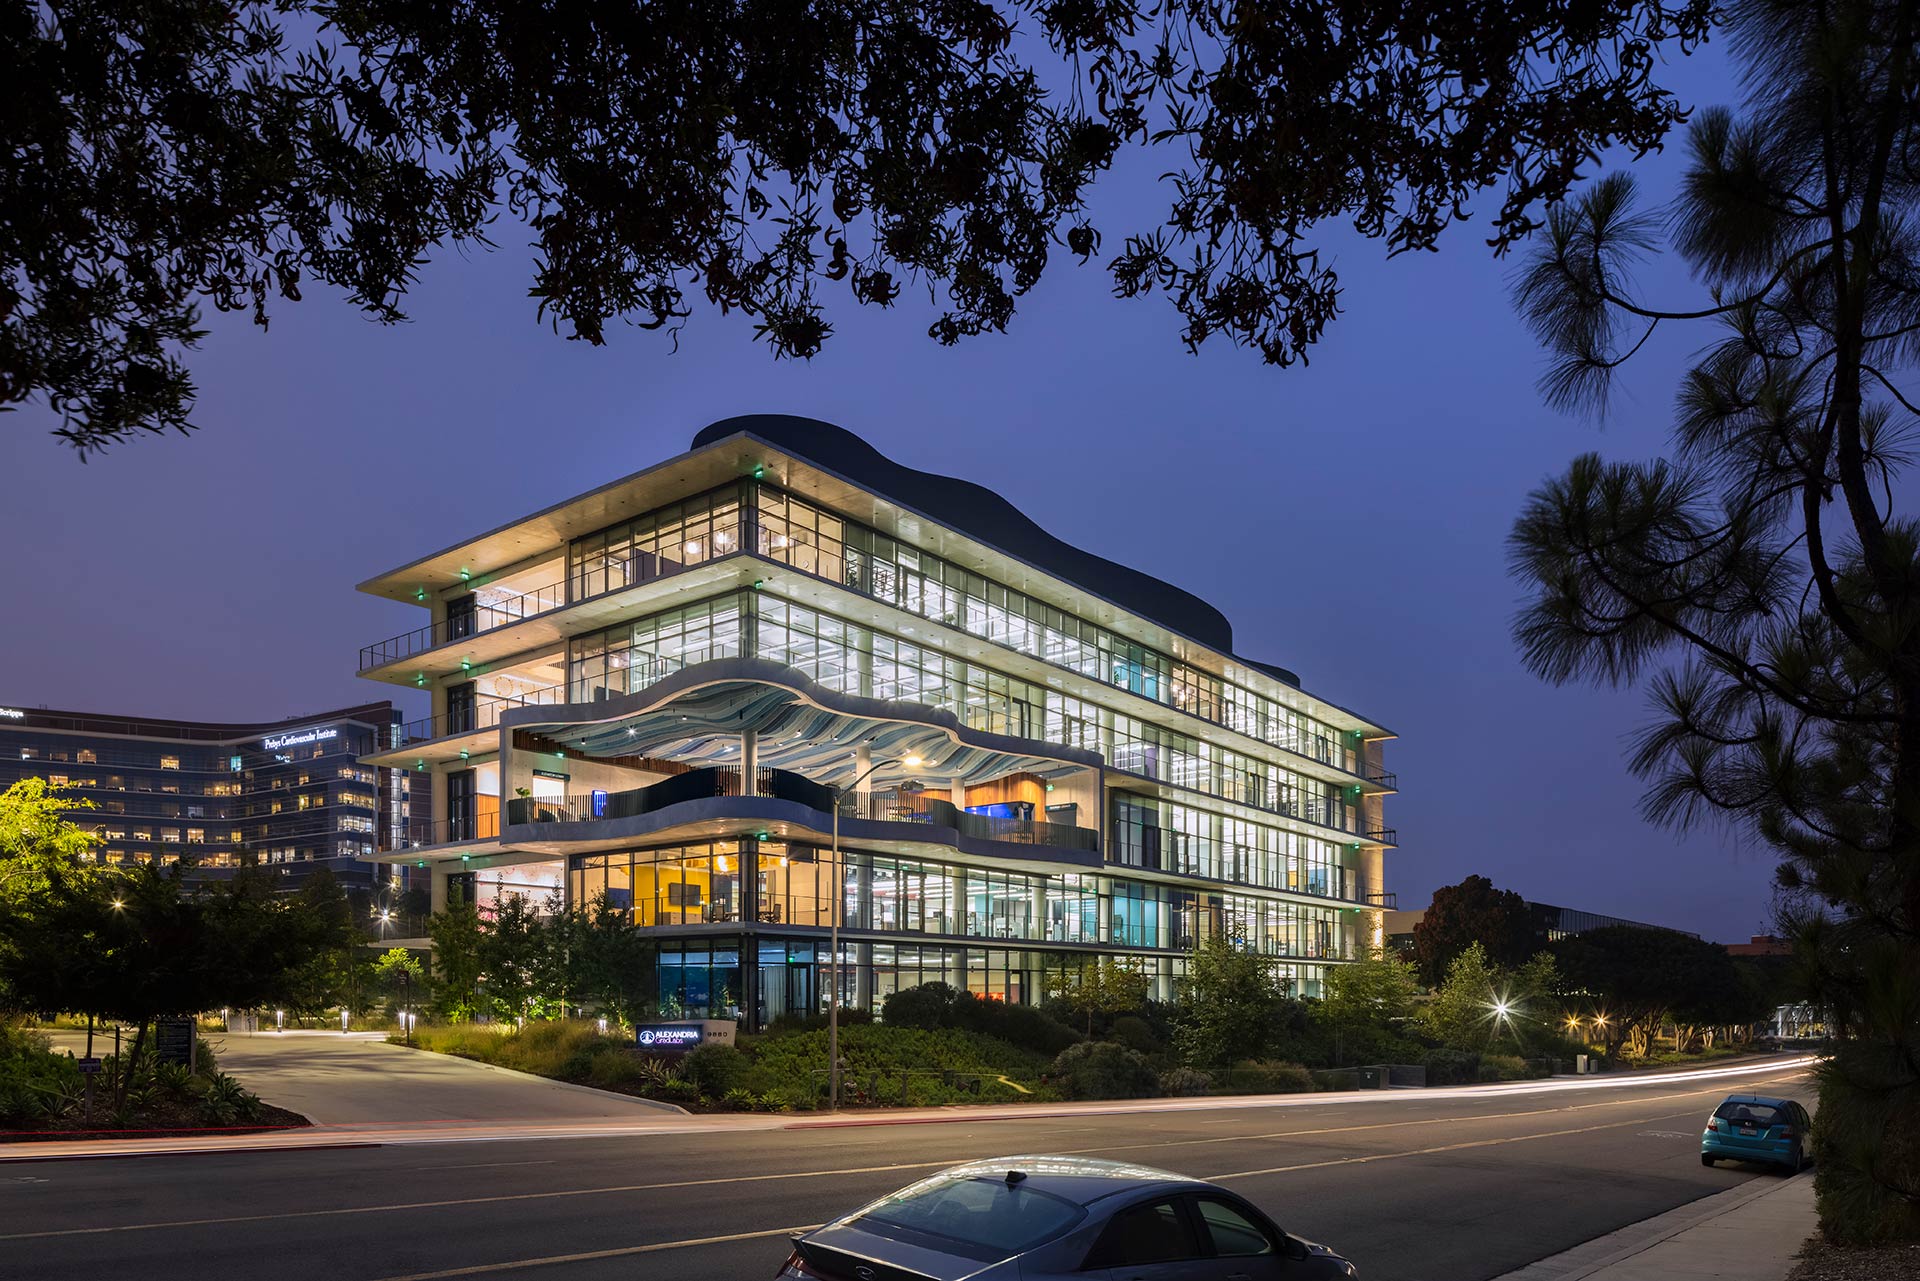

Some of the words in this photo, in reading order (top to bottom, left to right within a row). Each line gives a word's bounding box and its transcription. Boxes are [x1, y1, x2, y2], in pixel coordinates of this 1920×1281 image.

[265, 739, 281, 749] Prebys
[281, 733, 316, 746] Cardiovascular
[316, 730, 336, 739] Institute
